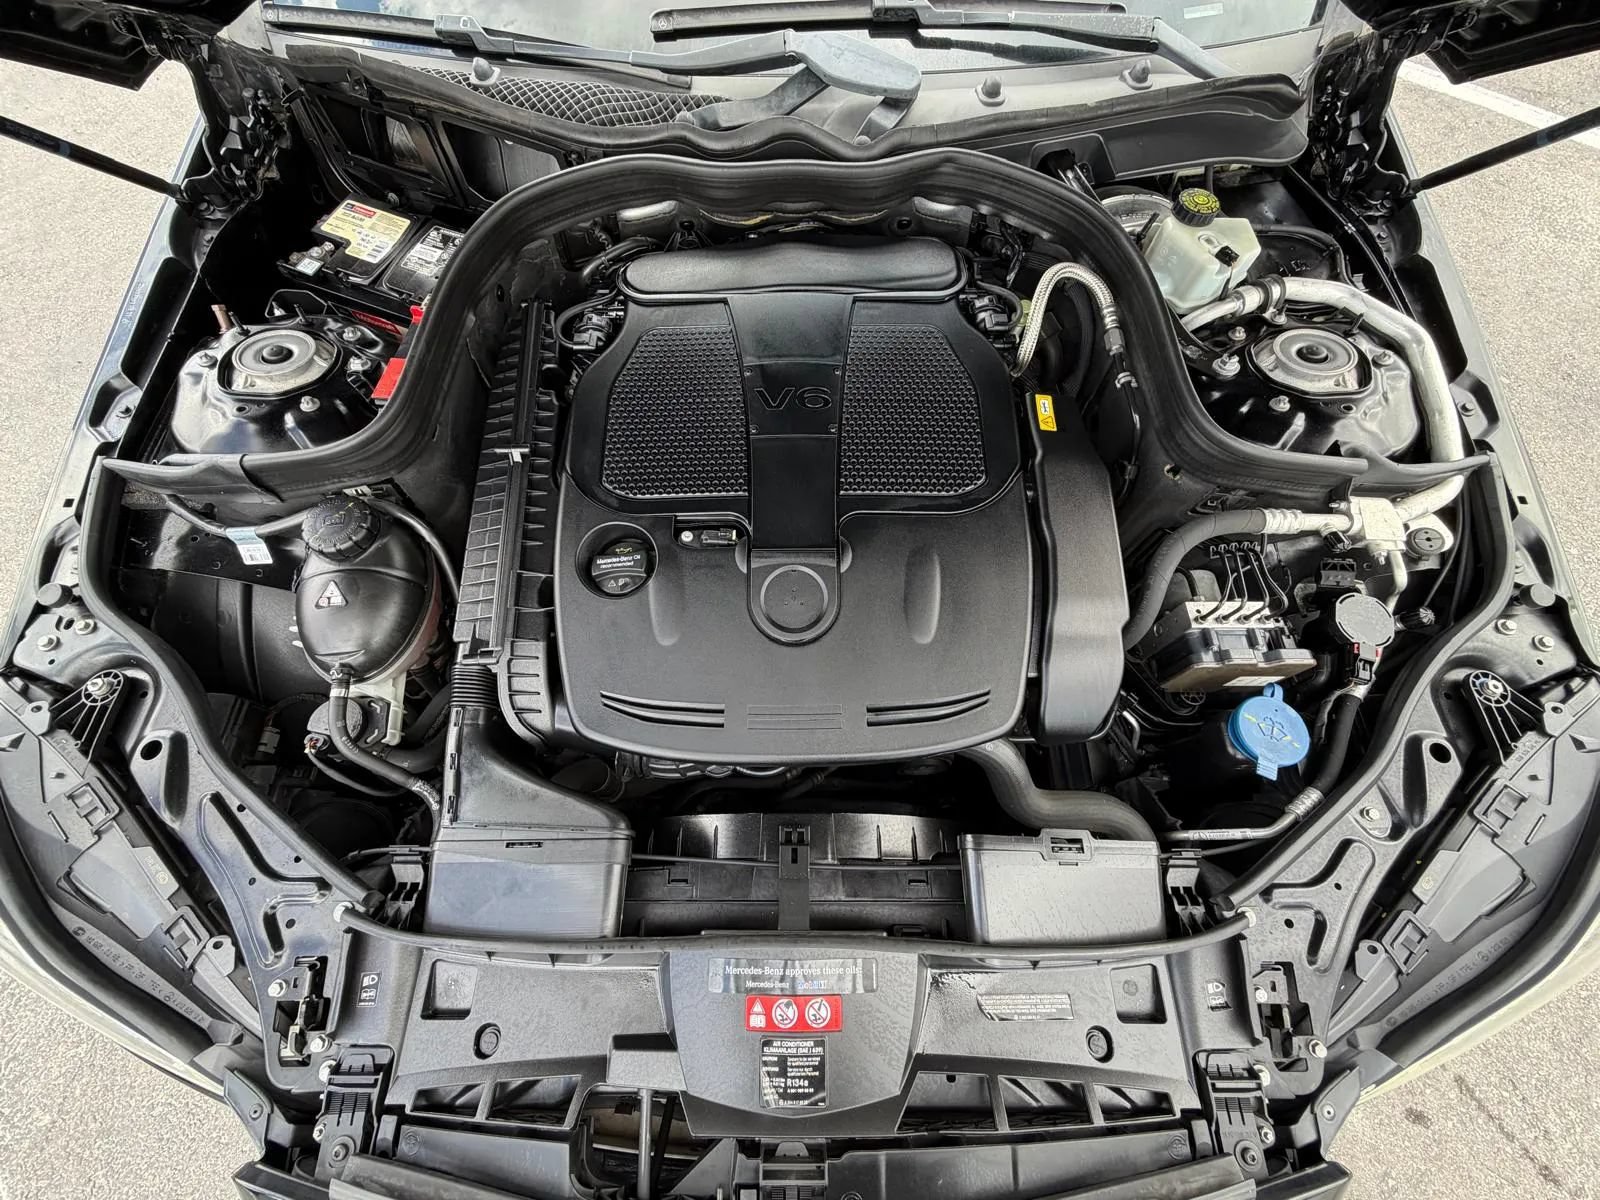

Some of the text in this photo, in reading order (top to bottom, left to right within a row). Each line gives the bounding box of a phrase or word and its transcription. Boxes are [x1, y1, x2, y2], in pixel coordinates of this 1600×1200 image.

[754, 386, 832, 411] V6
[597, 555, 633, 565] Mercedes-Benz
[725, 965, 863, 976] Mercedes-Benz approves these oils:
[745, 980, 790, 988] Mercedes-Benz
